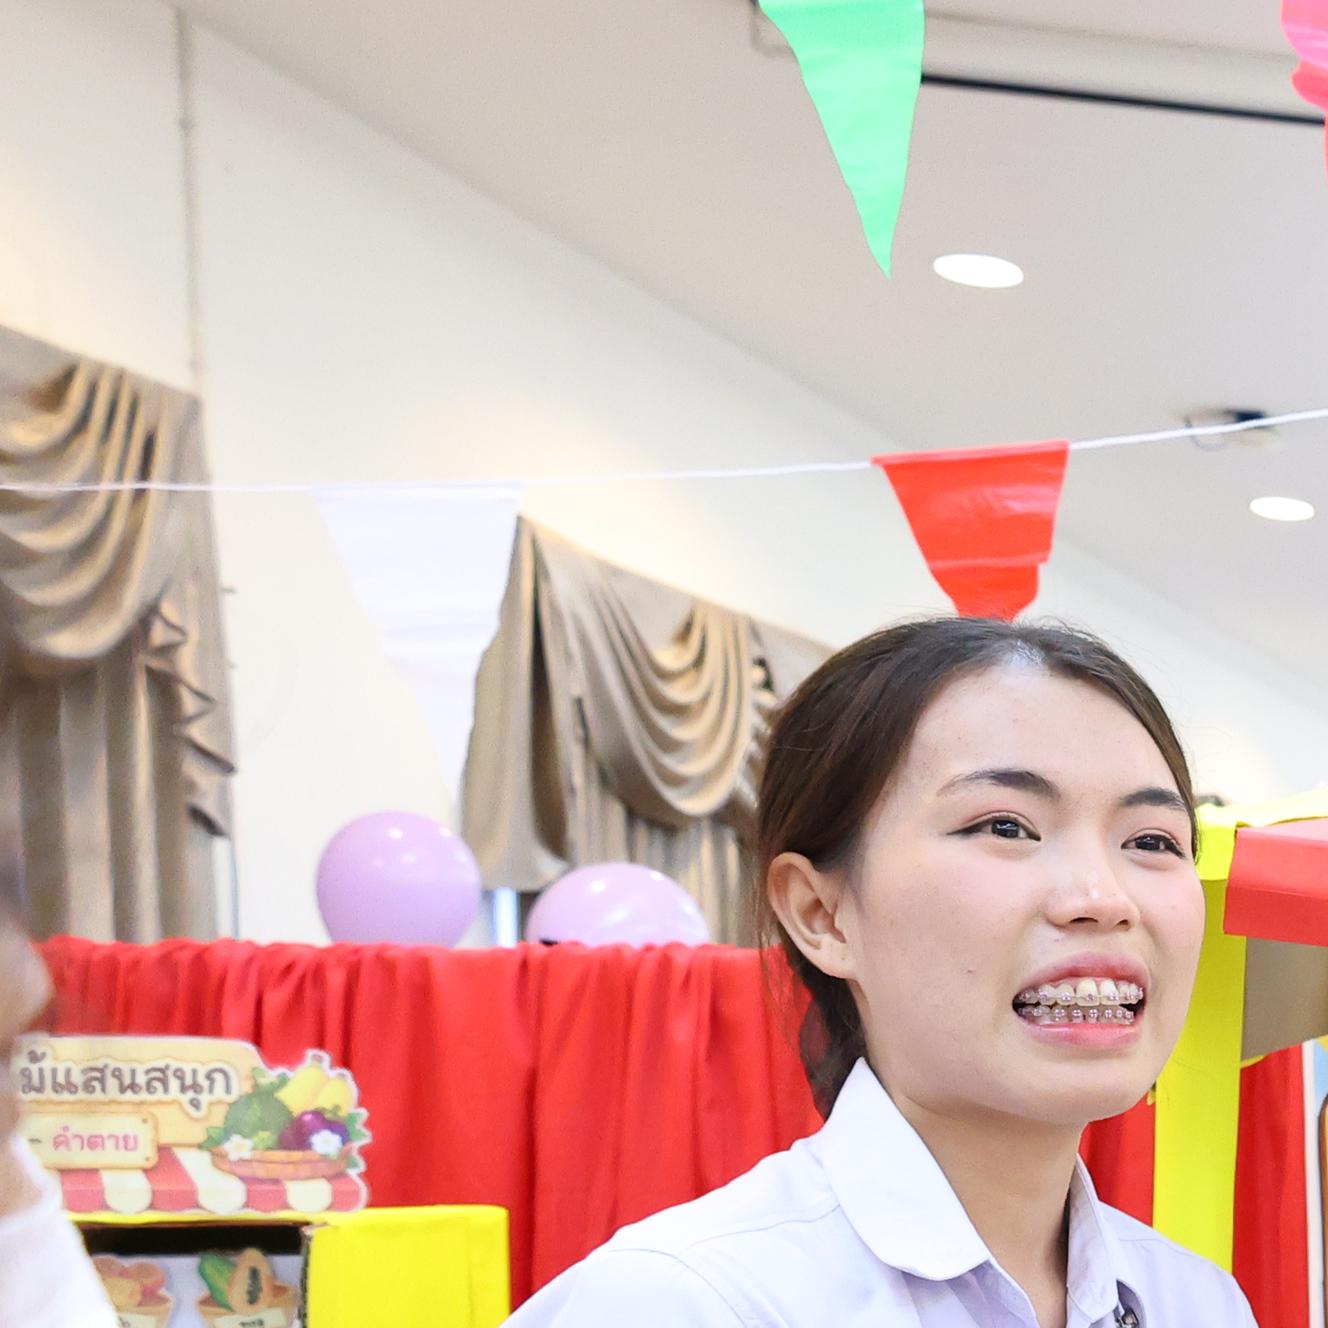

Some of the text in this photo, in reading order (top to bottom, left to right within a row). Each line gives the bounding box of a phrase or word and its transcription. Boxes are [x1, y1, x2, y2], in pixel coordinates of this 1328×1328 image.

[20, 1050, 232, 1111] ม้แสนสนุก
[52, 1126, 139, 1151] คำตาย
